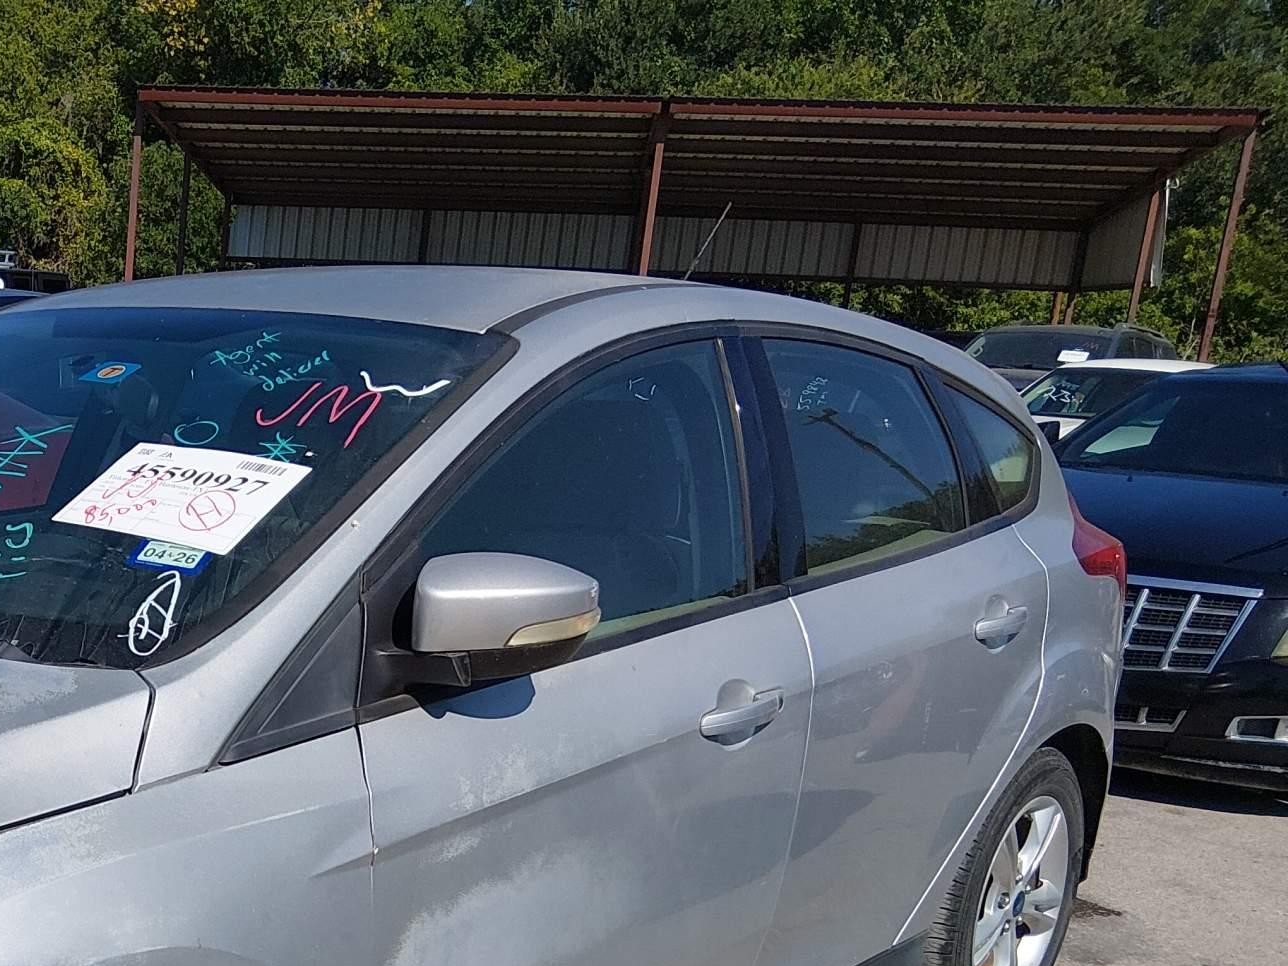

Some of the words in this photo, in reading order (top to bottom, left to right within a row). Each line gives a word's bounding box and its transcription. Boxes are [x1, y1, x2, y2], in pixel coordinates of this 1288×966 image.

[210, 331, 282, 366] Agent
[125, 461, 272, 497] 45590927
[143, 547, 164, 560] 04
[173, 551, 199, 565] 26
